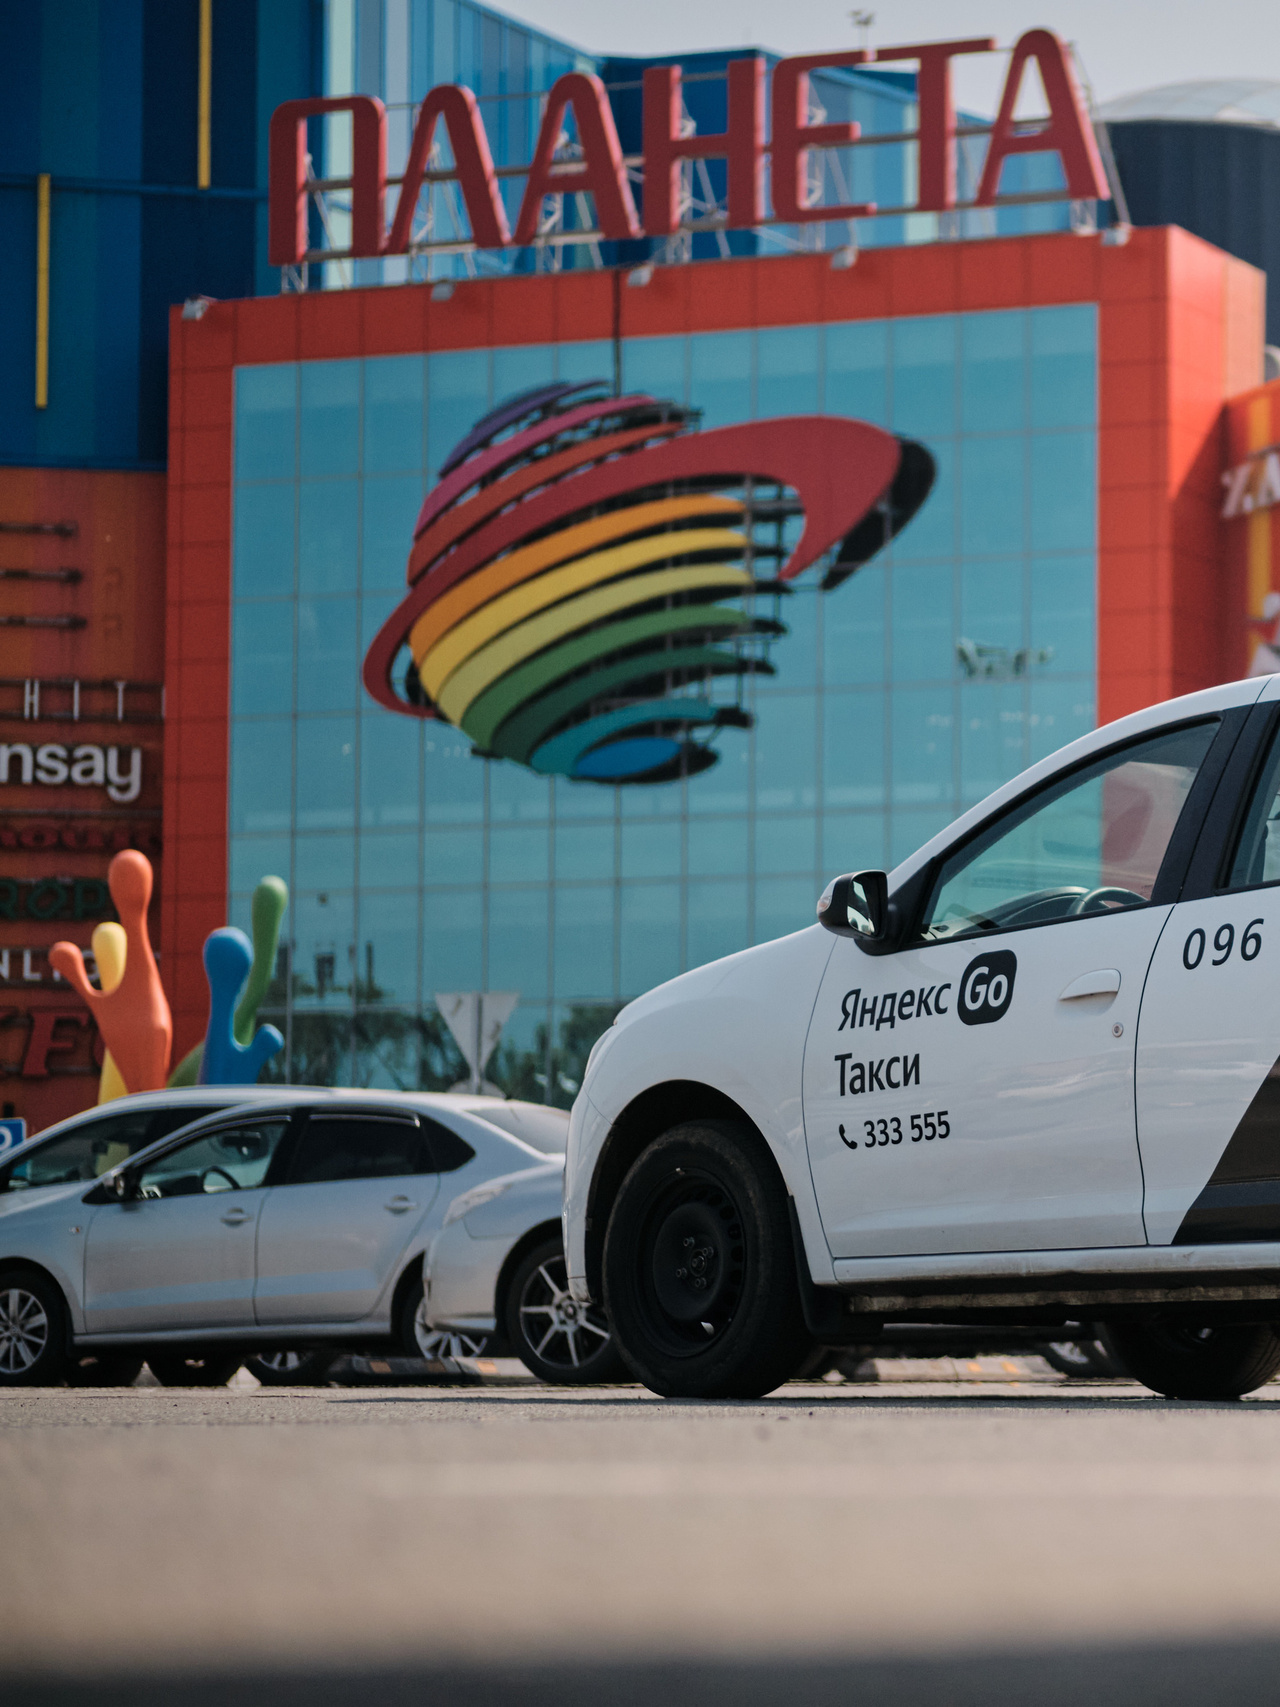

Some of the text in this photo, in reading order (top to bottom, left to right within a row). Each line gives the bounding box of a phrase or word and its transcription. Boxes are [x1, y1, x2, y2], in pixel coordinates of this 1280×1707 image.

[268, 27, 1110, 266] ПЛАНЕТА
[1182, 918, 1265, 970] 096
[837, 966, 1009, 1032] Яндекс Go
[834, 1052, 920, 1097] Такси
[863, 1110, 951, 1148] 333 555
